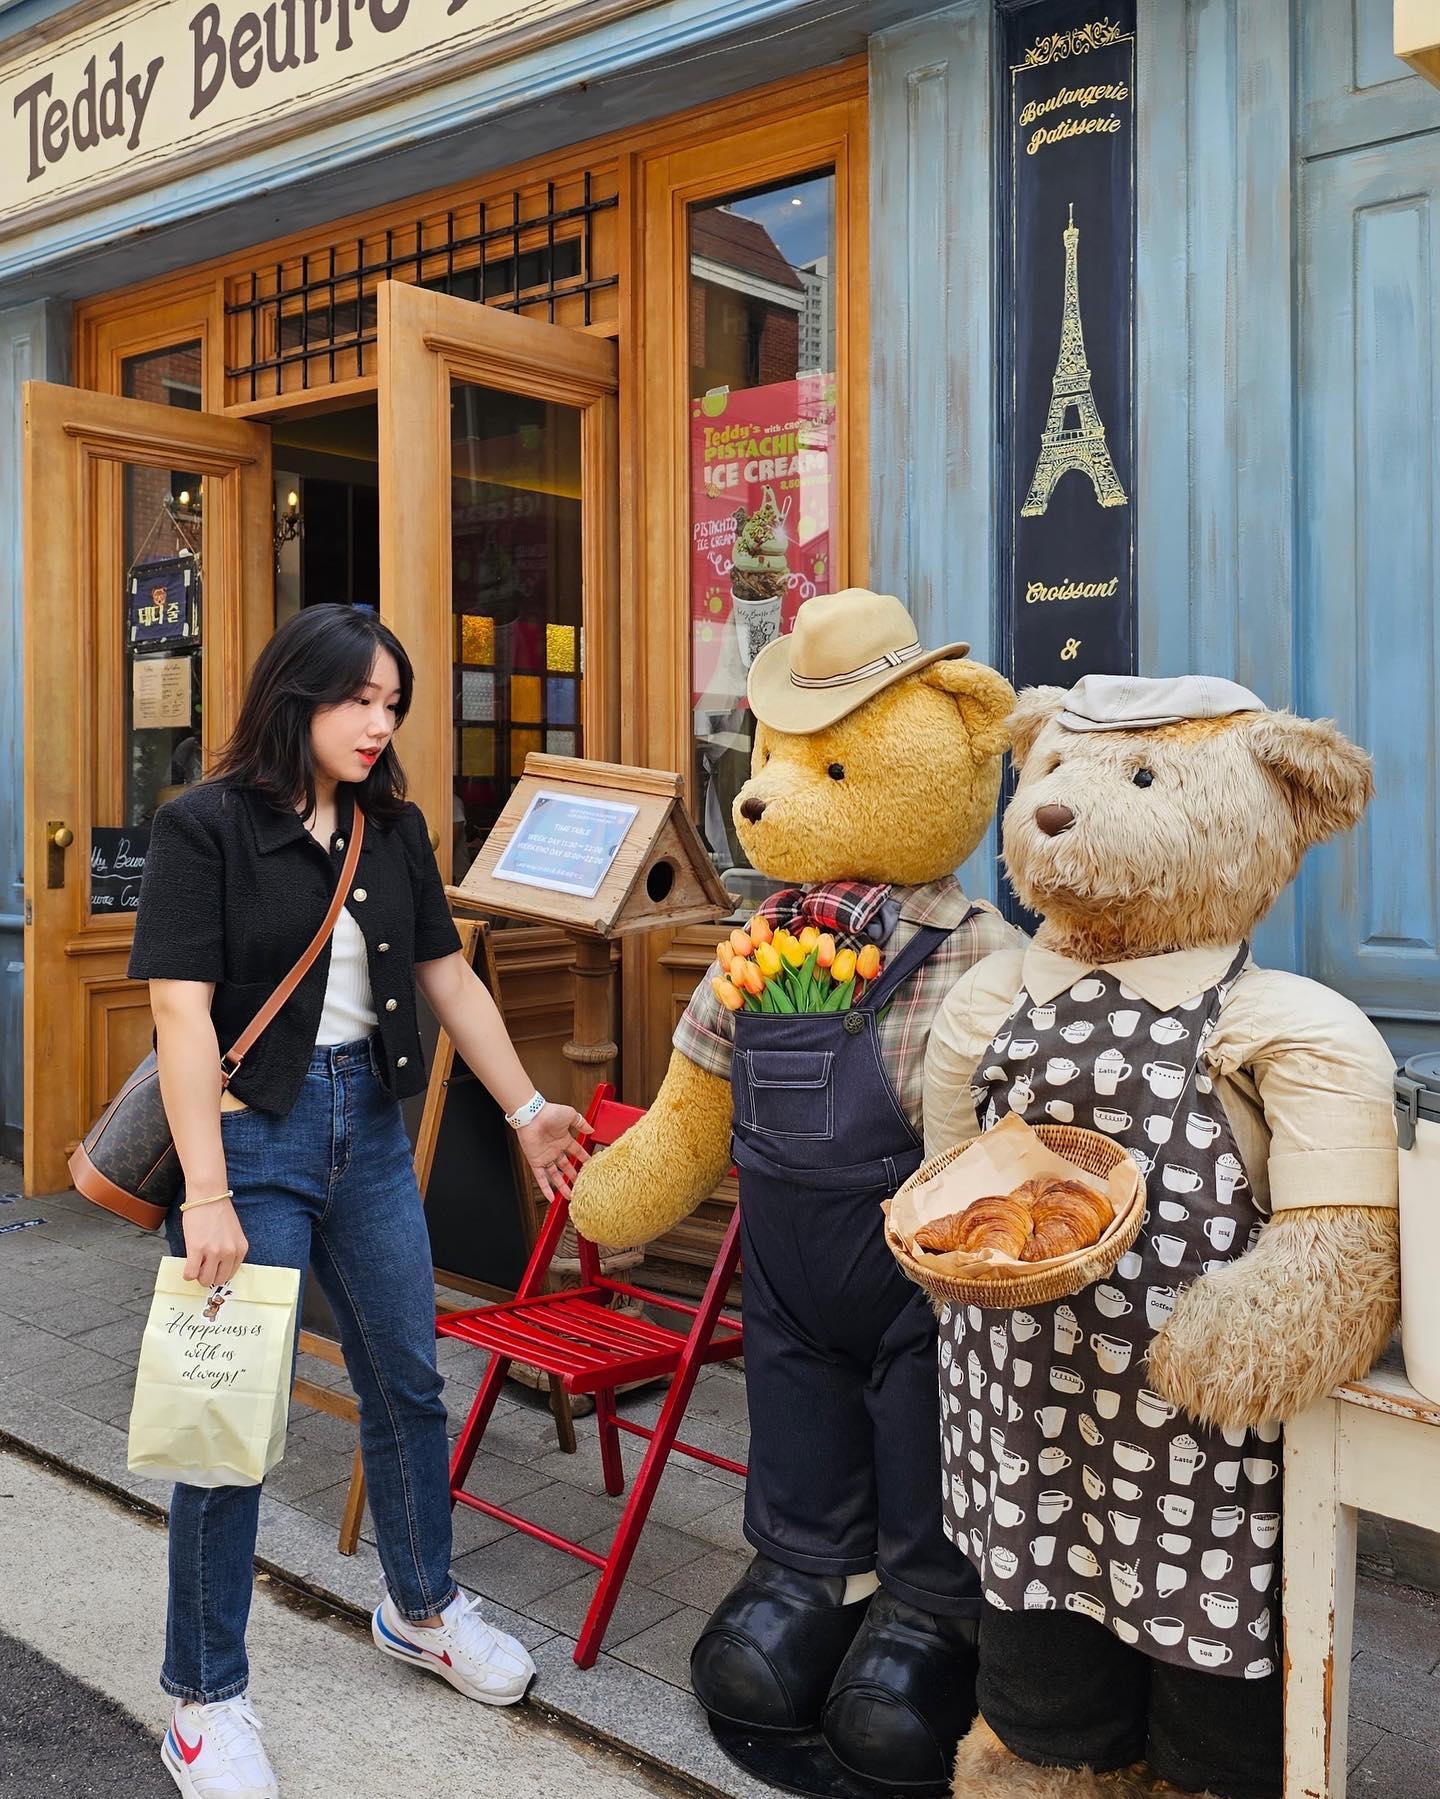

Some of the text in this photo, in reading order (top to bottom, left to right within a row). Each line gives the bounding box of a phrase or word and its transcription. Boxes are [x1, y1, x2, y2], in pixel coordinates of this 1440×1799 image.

[13, 41, 164, 183] Teddy
[1019, 81, 1129, 126] Boulangerie
[1027, 113, 1121, 155] Patisserie
[704, 423, 761, 448] Teddy's
[704, 462, 739, 489] ICE
[1026, 576, 1119, 604] Croissant
[137, 604, 164, 627] 테디
[1060, 637, 1082, 661] &
[1150, 1300, 1173, 1312] Coffee
[250, 1322, 263, 1336] is
[184, 1341, 236, 1361] with us
[1173, 1456, 1194, 1464] Latte
[1171, 1506, 1188, 1516] mug
[1200, 1649, 1213, 1658] tea
